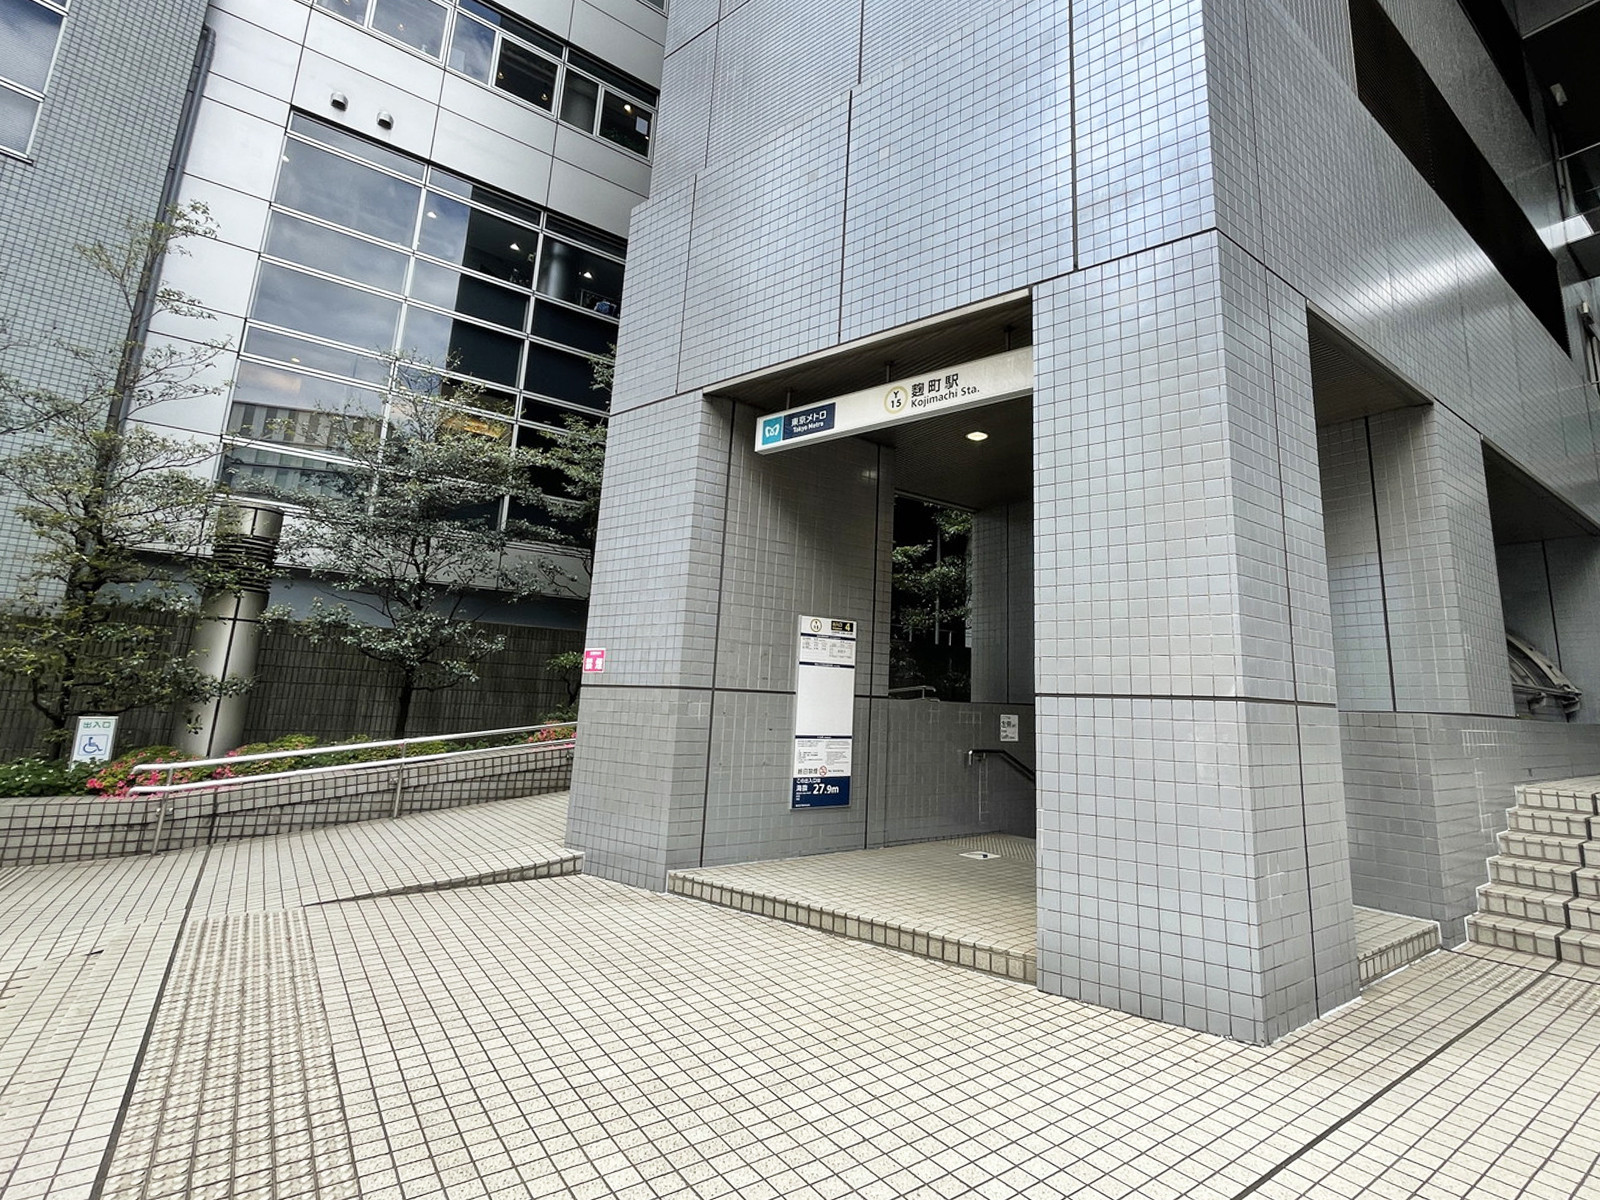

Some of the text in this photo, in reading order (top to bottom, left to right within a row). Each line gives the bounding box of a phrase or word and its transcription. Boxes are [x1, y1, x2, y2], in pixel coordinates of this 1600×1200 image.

[893, 390, 899, 399] Y
[911, 386, 980, 408] Kojimachi Sta.
[890, 398, 902, 409] 15
[791, 410, 827, 427] 東京メトロ
[793, 421, 824, 433] Tokyo Metro
[845, 623, 851, 631] 4
[83, 721, 111, 729] 出入口
[813, 784, 839, 794] 27.9m
